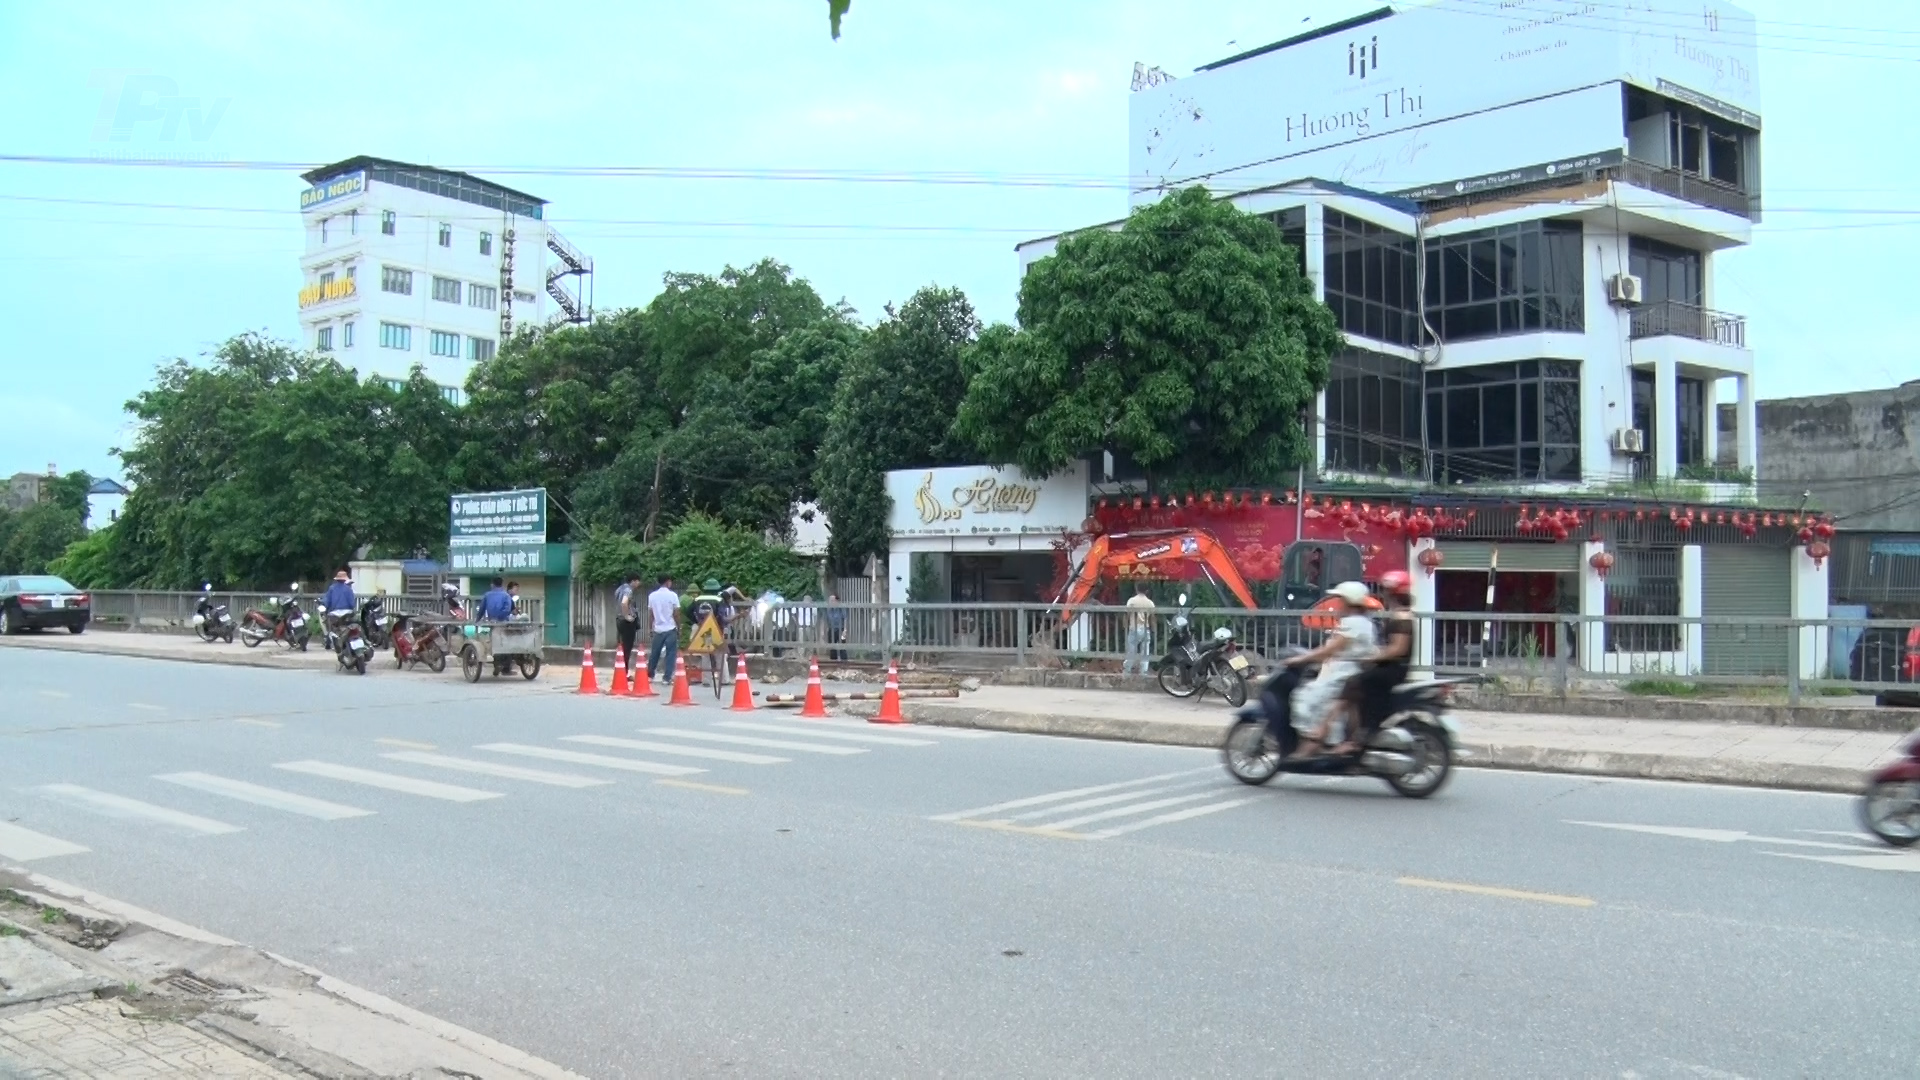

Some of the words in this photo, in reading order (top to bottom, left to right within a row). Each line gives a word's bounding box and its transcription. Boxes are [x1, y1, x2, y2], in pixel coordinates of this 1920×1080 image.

[1285, 107, 1370, 141] Hương
[1375, 84, 1423, 118] Thị
[327, 176, 361, 198] NGỌC
